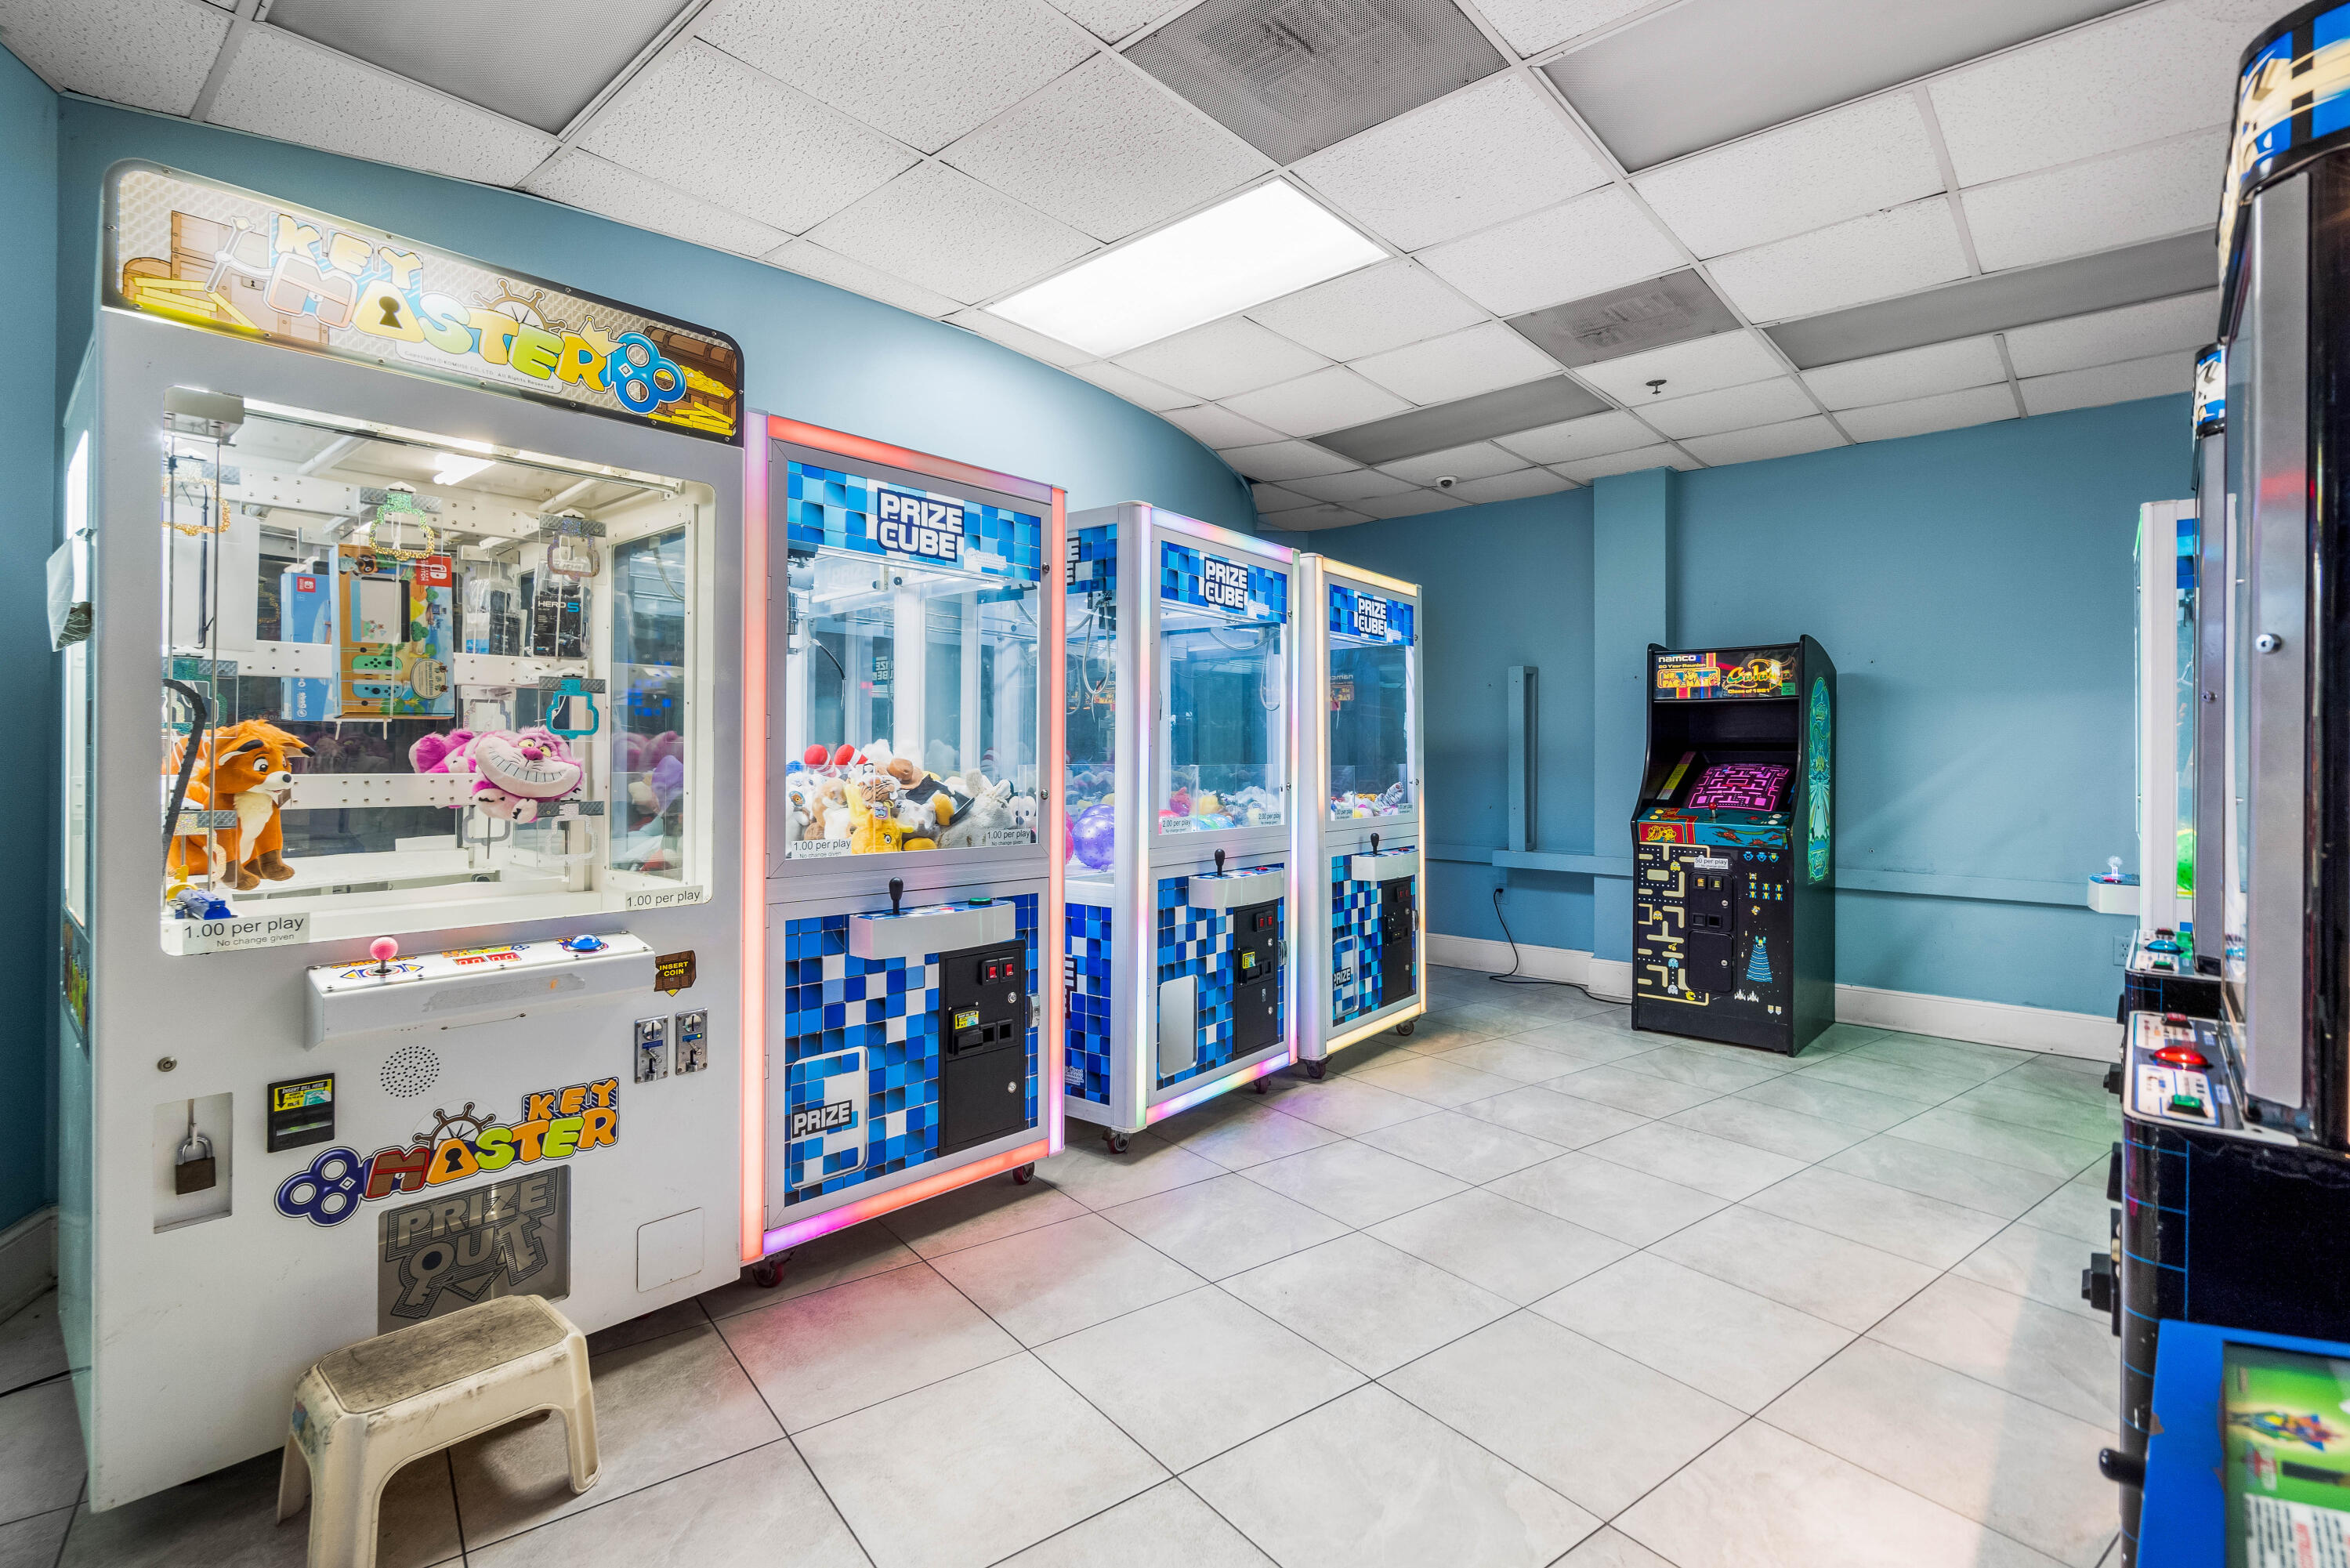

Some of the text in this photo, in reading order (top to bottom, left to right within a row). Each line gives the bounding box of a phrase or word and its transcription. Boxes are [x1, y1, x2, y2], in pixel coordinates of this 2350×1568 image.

[275, 214, 422, 289] KEY
[267, 253, 608, 393] MASTER
[528, 379, 554, 389] Reserved
[880, 492, 963, 534] PRIZE
[879, 521, 956, 560] CUBE
[1205, 559, 1247, 589] PRIZE
[1205, 581, 1244, 609] CUBE
[1358, 598, 1386, 620] PRIZE
[1358, 615, 1385, 636] CUBE
[1726, 664, 1794, 684] Galaa
[987, 831, 1002, 839] 1.00
[1017, 829, 1030, 839] play
[1162, 819, 1175, 827] 2.00
[793, 838, 851, 851] 1.00 per play
[627, 890, 701, 907] 1.00 per play
[184, 918, 304, 939] 1.00 per play
[233, 936, 267, 945] change
[270, 934, 295, 943] given
[659, 961, 689, 971] INSERT
[664, 969, 684, 977] COIN
[527, 1078, 617, 1121] KEY
[794, 1102, 849, 1135] PRIZE
[365, 1106, 617, 1198] MASTER
[396, 1174, 550, 1248] PRIZE
[404, 1216, 541, 1307] OUT
